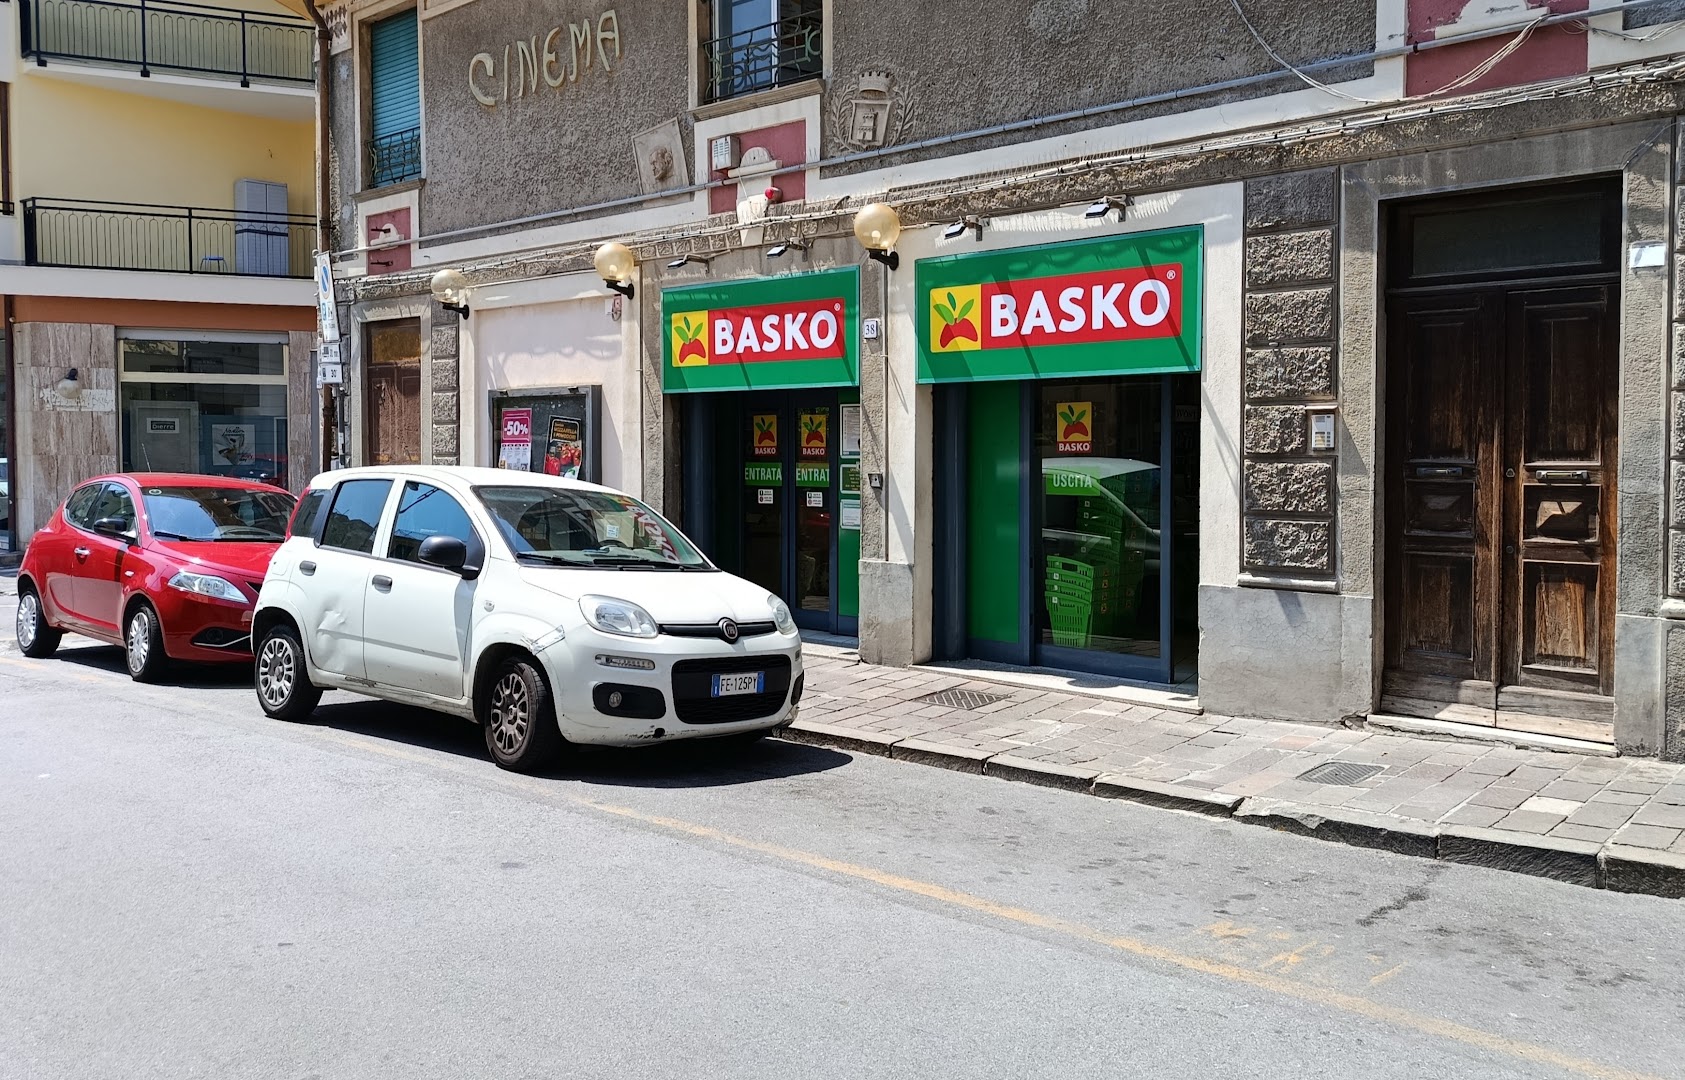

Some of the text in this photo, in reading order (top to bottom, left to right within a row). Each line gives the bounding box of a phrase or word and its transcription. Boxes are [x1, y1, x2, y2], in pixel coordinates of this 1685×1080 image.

[469, 9, 620, 106] CINEMA
[989, 278, 1171, 338] BASKO
[714, 309, 838, 355] BASKO
[865, 324, 875, 335] 38
[503, 420, 528, 436] -50%
[754, 447, 777, 455] BASKO
[802, 447, 825, 456] BASKO
[1058, 442, 1091, 452] BASKO
[744, 467, 782, 481] ENTRATA
[1053, 473, 1093, 488] USCITA
